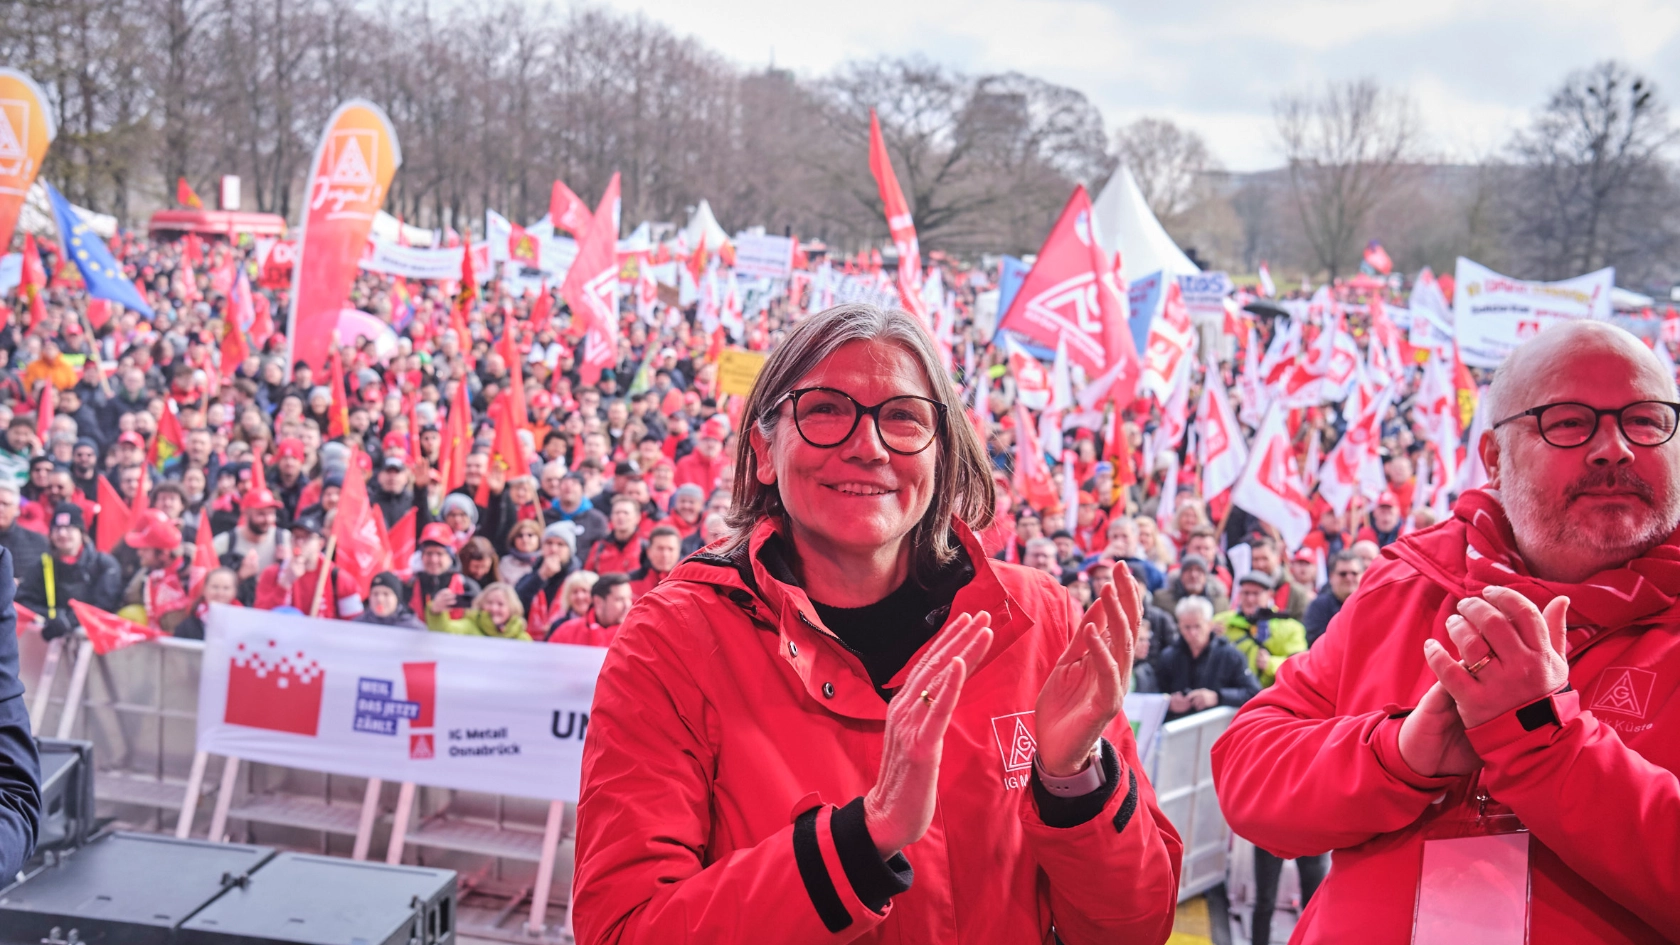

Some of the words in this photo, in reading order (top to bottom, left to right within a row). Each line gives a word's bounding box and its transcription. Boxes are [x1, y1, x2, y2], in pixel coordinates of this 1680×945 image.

[361, 681, 389, 696] WEIL
[359, 699, 382, 713] DAS
[383, 702, 419, 718] JETZT
[449, 729, 462, 740] IG
[466, 727, 508, 739] Metall
[1614, 720, 1653, 733] Küste
[449, 742, 520, 757] Osnabrück
